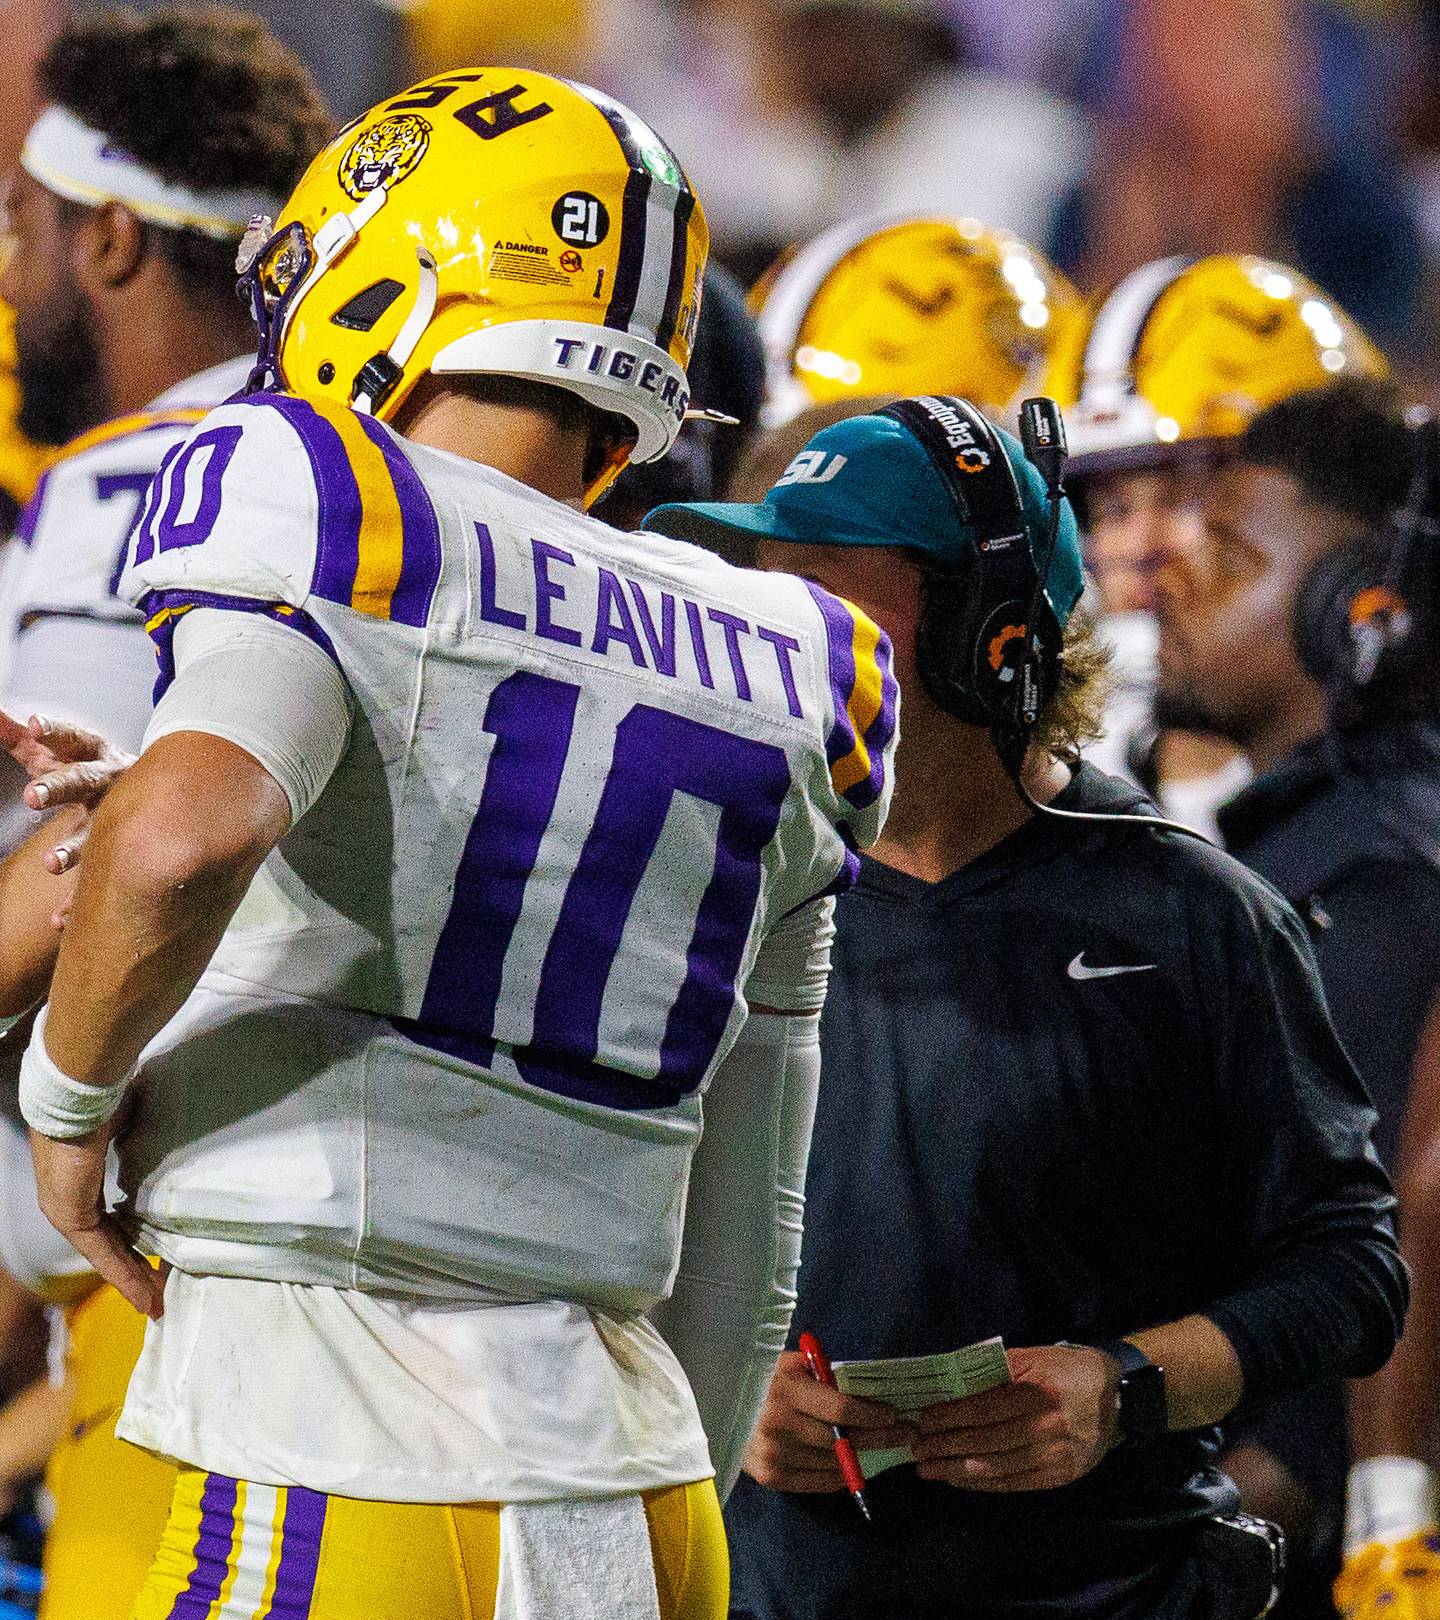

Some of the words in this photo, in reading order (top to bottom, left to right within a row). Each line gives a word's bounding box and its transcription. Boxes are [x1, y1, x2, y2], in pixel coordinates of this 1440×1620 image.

[505, 241, 549, 256] DANGER
[561, 197, 598, 243] 21
[554, 337, 691, 422] TIGERS
[132, 425, 244, 568] 10
[774, 450, 849, 487] SU
[473, 520, 804, 719] LEAVITT
[391, 670, 792, 1110] 10
